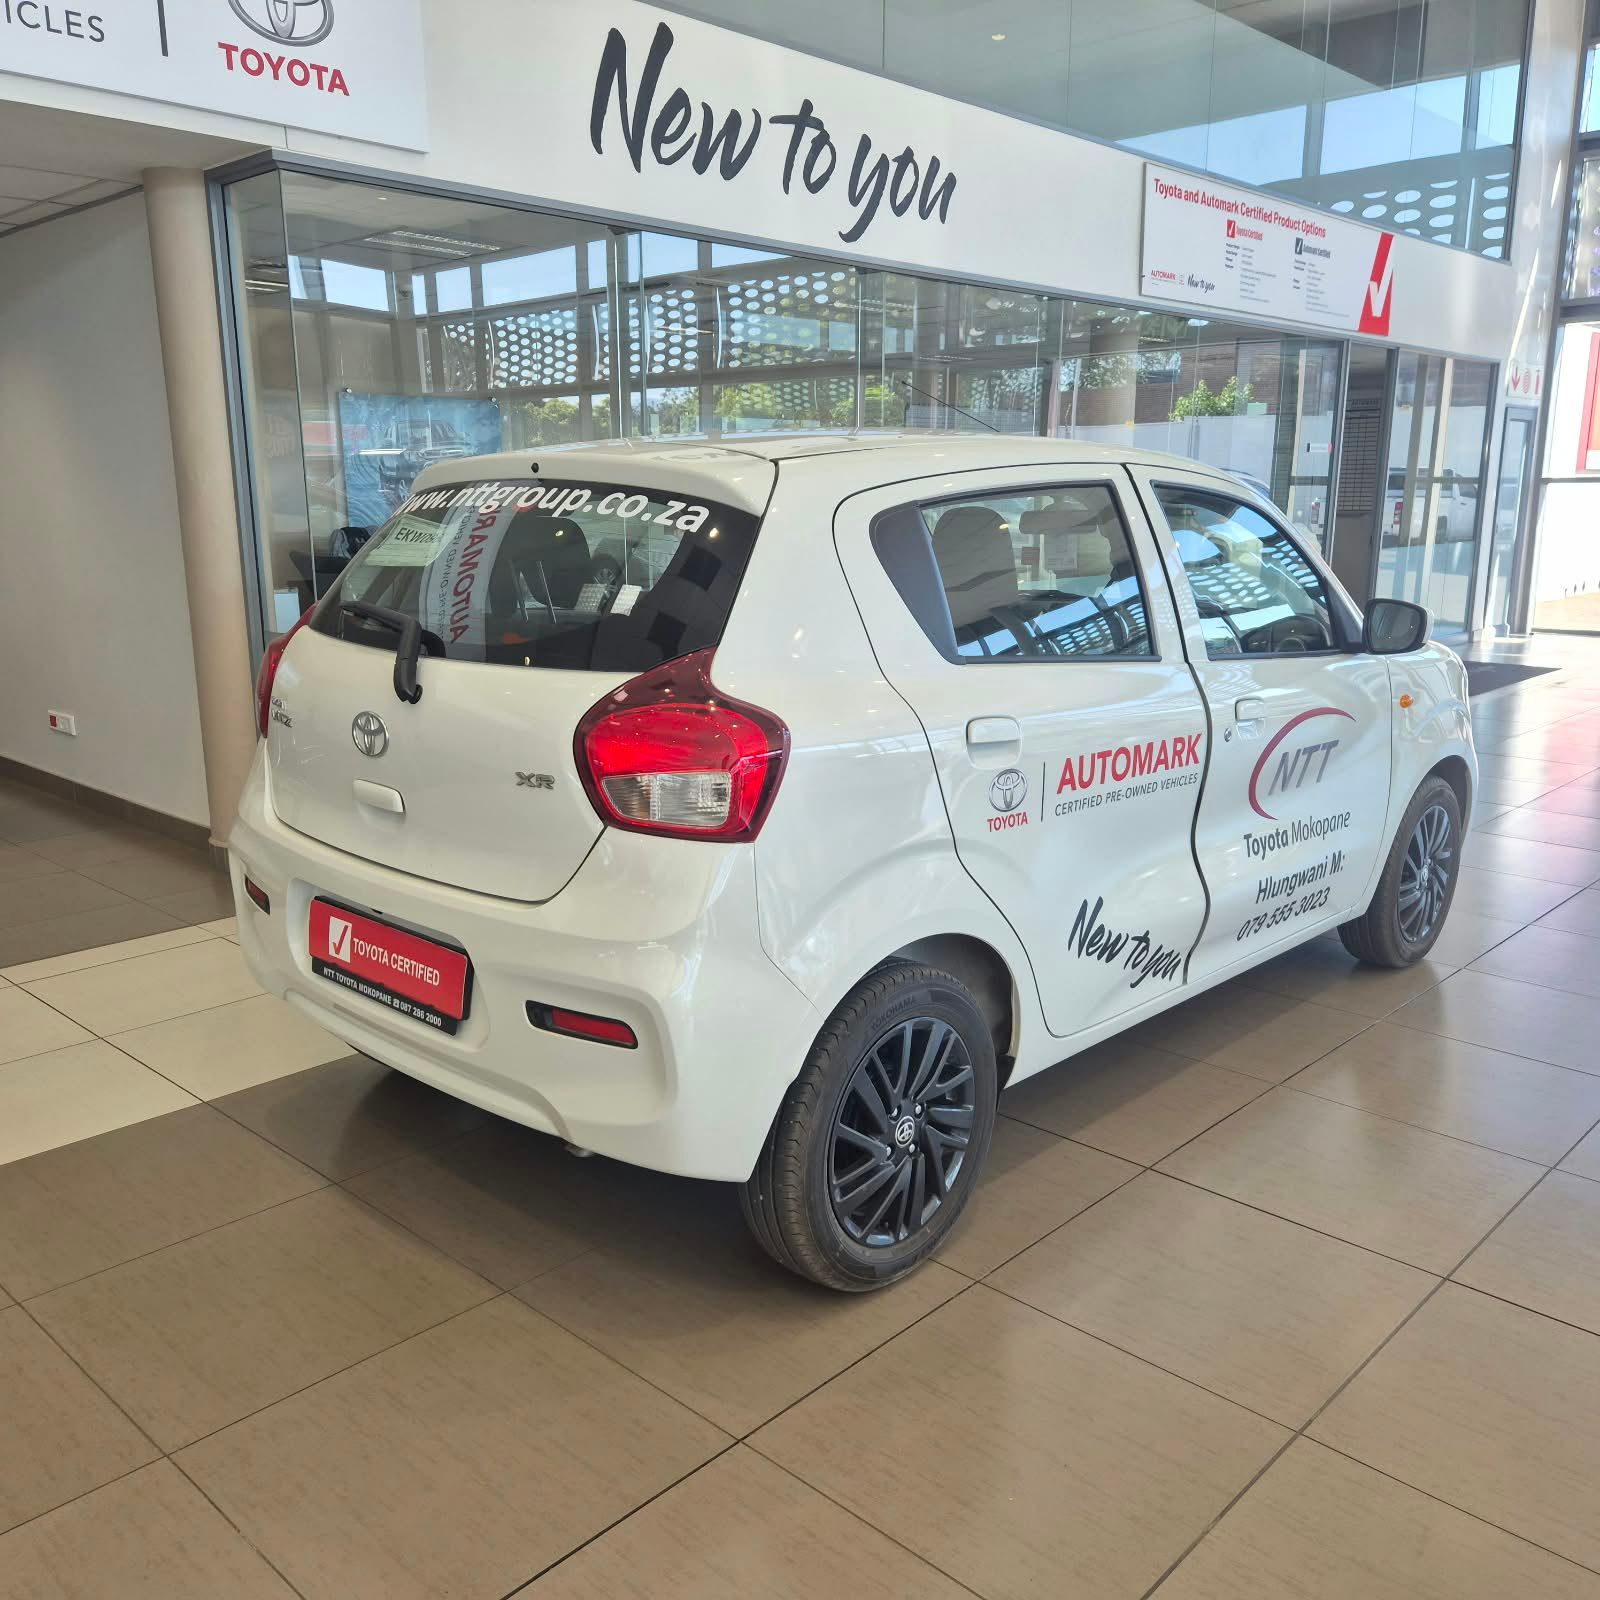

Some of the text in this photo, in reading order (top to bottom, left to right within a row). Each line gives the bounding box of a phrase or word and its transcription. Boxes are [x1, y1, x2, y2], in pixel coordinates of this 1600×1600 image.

[218, 41, 350, 97] TOYOTA
[590, 21, 957, 243] New to you
[1153, 178, 1326, 239] Toyota and Automark Certified Product Options
[514, 771, 555, 790] XR
[1056, 733, 1202, 795] AUTOMARK
[1267, 738, 1340, 796] NTT
[987, 811, 1029, 833] TOYOTA
[1054, 772, 1199, 818] CERTIFIED PRE-OWNED VEHICLES
[1243, 810, 1352, 862] Toyota Mokopane
[1255, 856, 1328, 904] Hlungwani
[1236, 886, 1331, 942] 079 555 3023
[353, 937, 440, 986] TOYOTA CERTIFIED
[1067, 896, 1182, 989] New to you
[323, 966, 336, 979] NTT
[335, 971, 358, 990] TOYOTA
[358, 982, 392, 1005] MOKOPANE
[400, 1001, 412, 1013] 087
[425, 1012, 442, 1027] 2000
